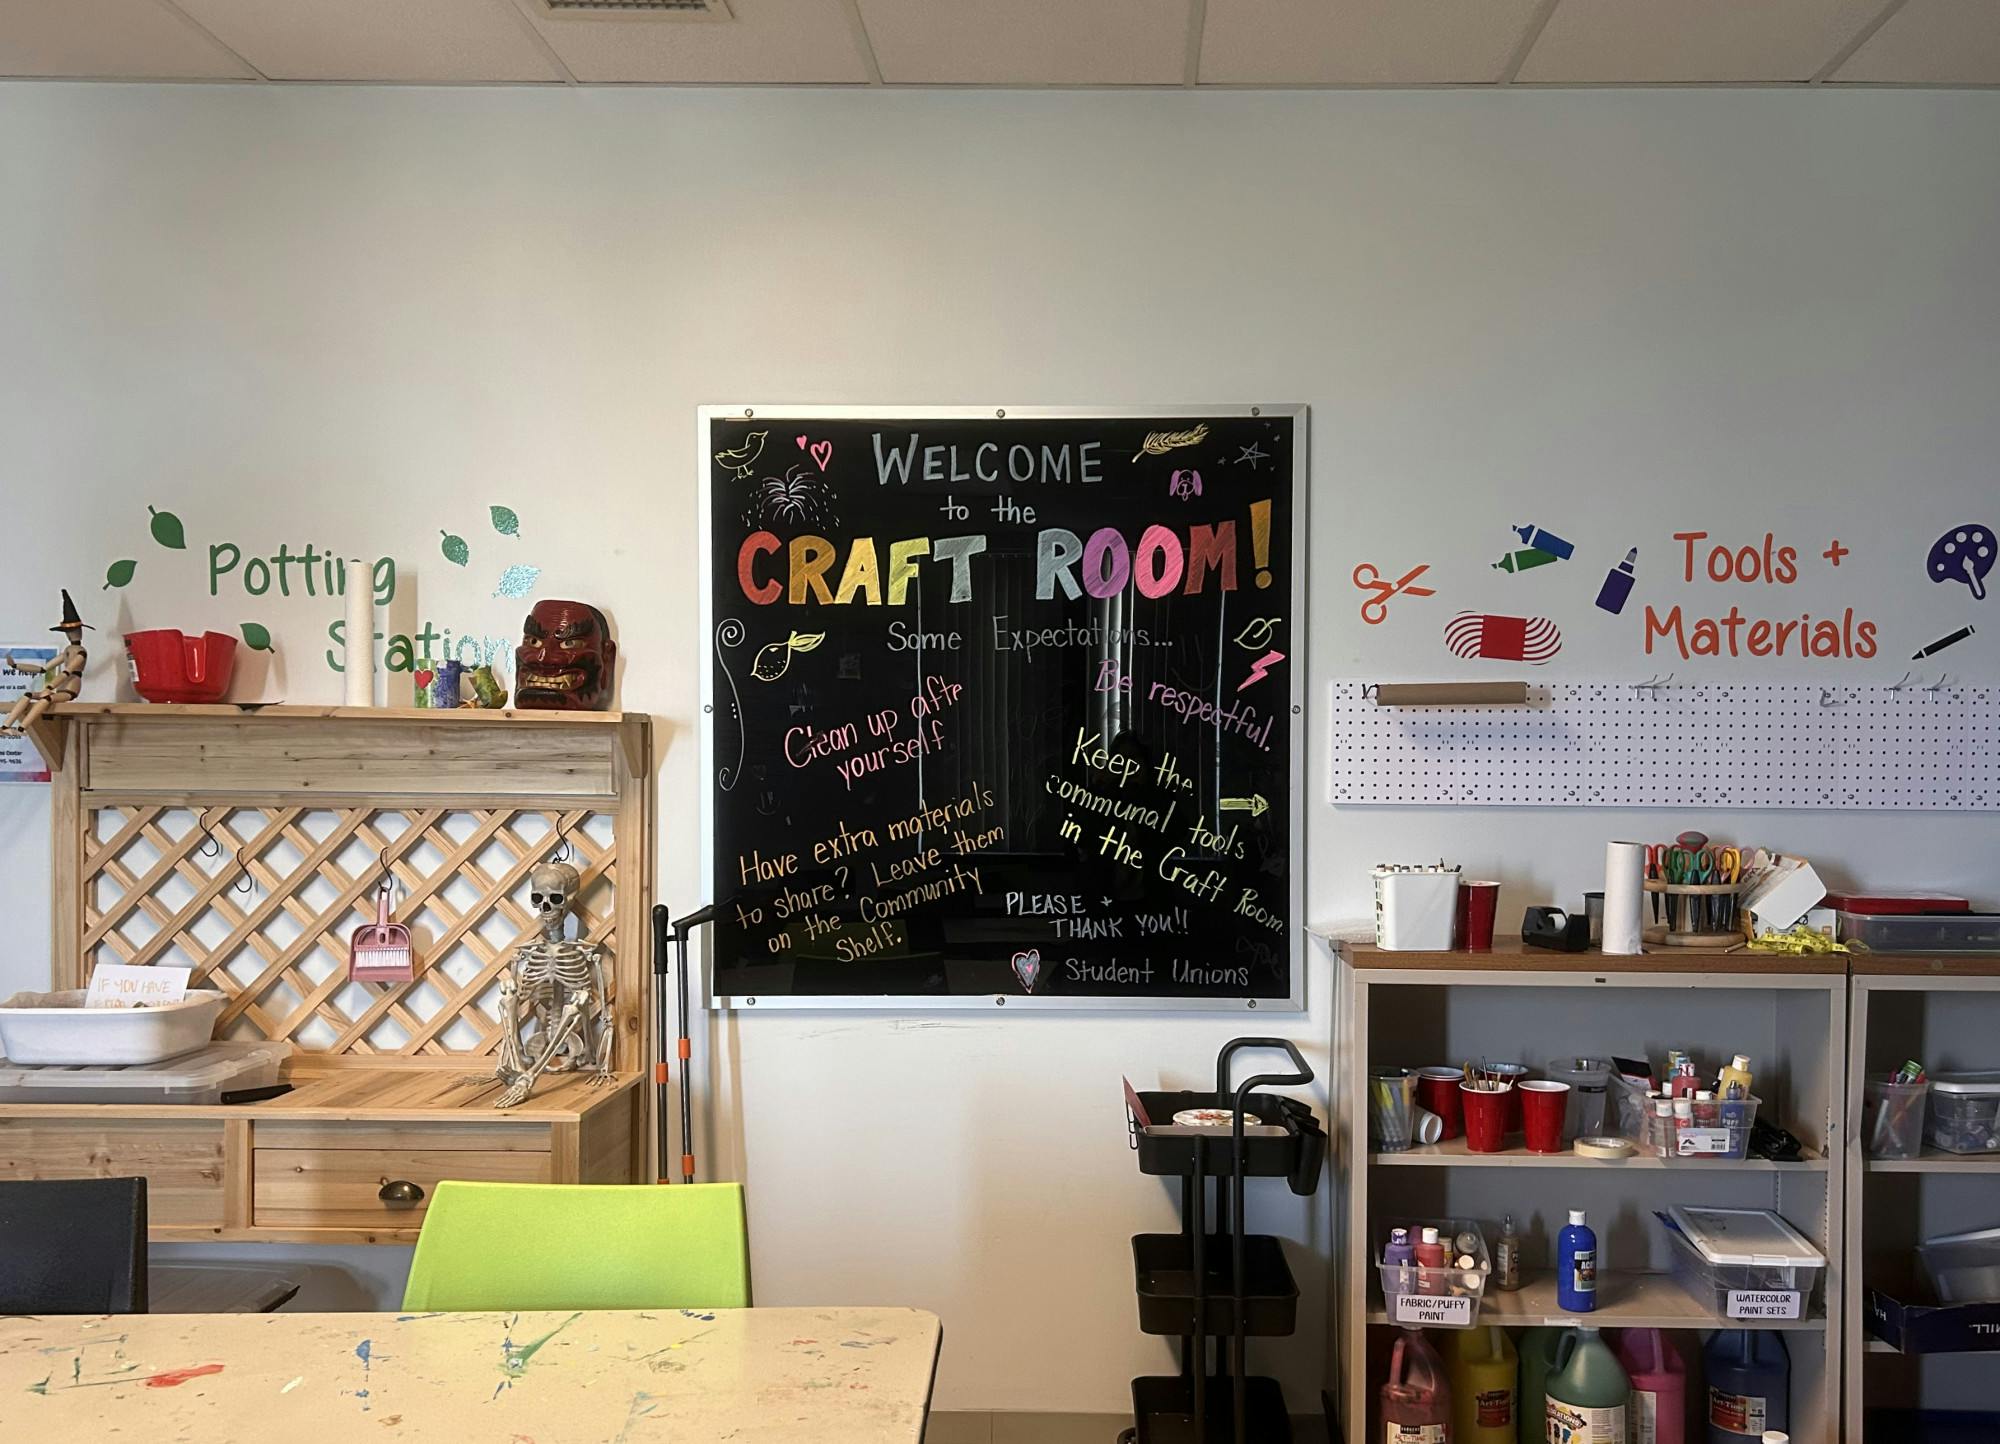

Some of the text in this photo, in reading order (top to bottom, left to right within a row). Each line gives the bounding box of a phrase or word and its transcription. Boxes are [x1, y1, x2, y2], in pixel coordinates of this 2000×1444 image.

[872, 433, 1104, 486] WELCOME
[940, 496, 1038, 525] to the
[737, 499, 1273, 606] CRAFT ROOM!
[1674, 531, 1849, 584] Tools +
[326, 621, 513, 673] Sation
[887, 621, 962, 651] Some
[1645, 605, 1880, 661] Materials
[1094, 659, 1274, 752] Be respectful.
[784, 725, 859, 769] Clean
[867, 709, 898, 743] up
[836, 719, 945, 792] yourself
[1071, 726, 1141, 788] Keep
[739, 781, 995, 886] Have extra materials
[1045, 775, 1245, 859] communal tools
[736, 825, 1005, 930] to share? Leave them
[1059, 813, 1284, 936] in the Craft Room.
[768, 863, 984, 953] on the Community
[1005, 891, 1086, 916] PLEASE
[1048, 917, 1124, 940] THANK
[835, 921, 903, 963] Shelf.
[141, 979, 172, 993] HAVE
[1064, 957, 1250, 986] Student Unions
[1400, 1297, 1466, 1309] FABRIC/PUFFY
[1419, 1311, 1446, 1321] PAINT
[1736, 1293, 1792, 1304] WATERCOLOR
[1739, 1305, 1787, 1315] PAINT SETS
